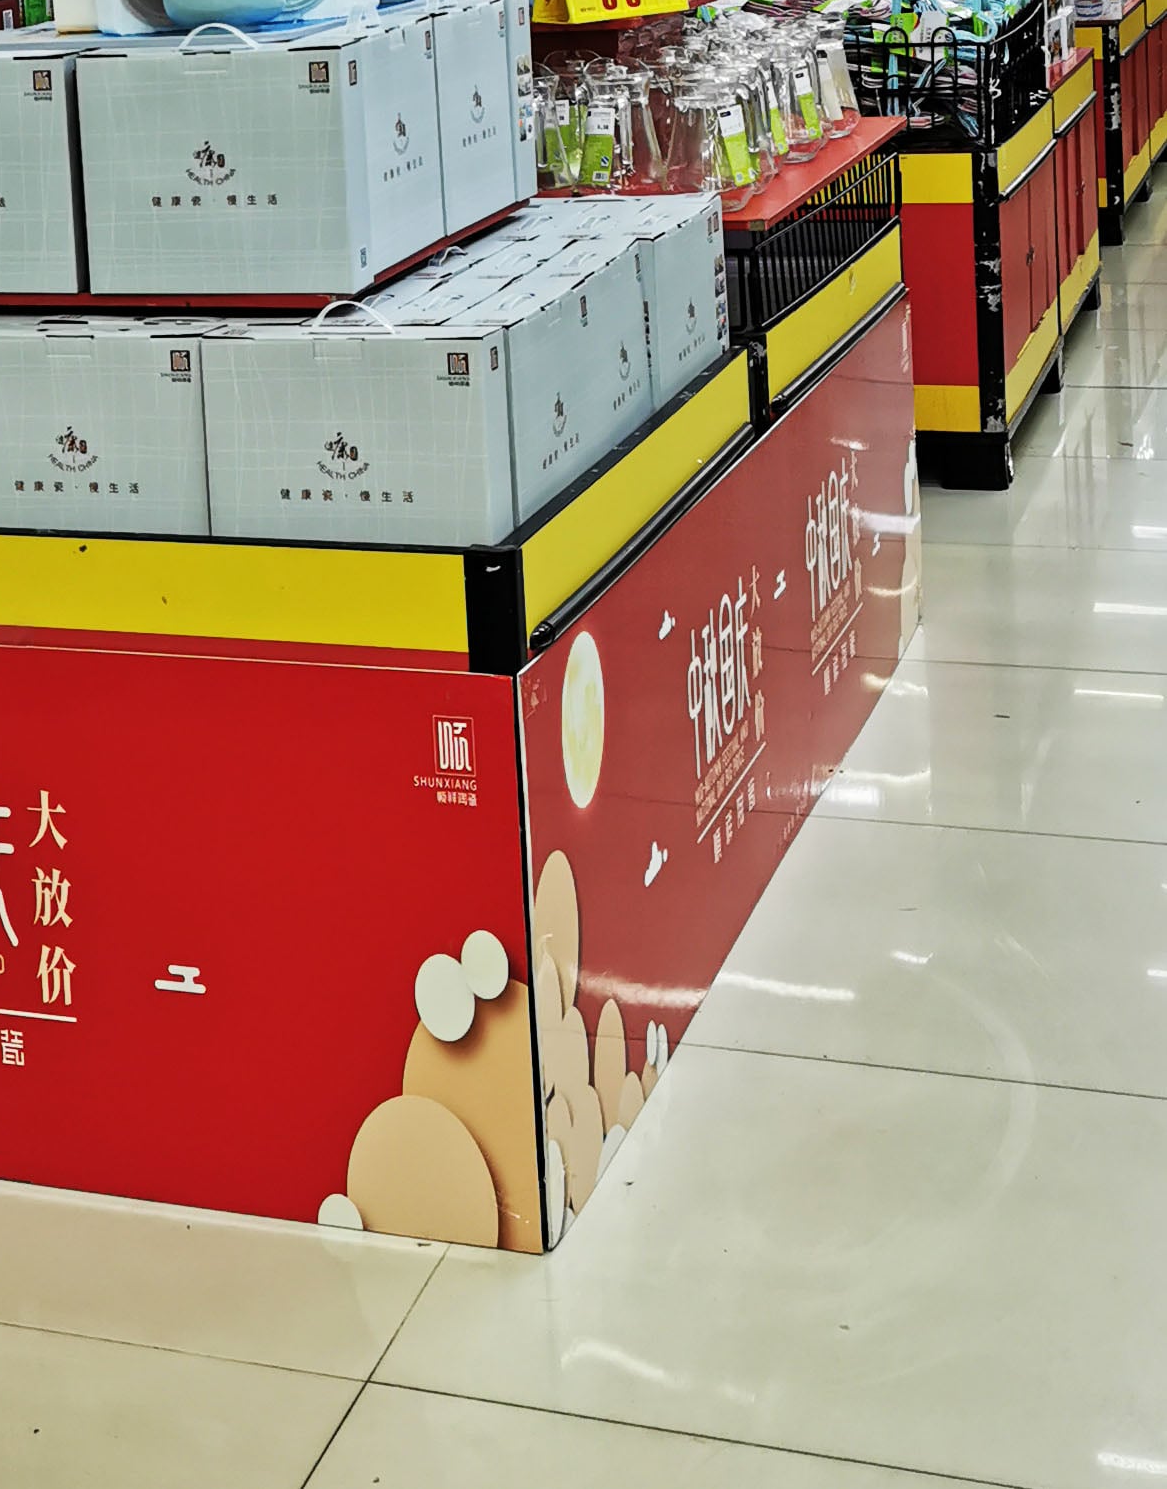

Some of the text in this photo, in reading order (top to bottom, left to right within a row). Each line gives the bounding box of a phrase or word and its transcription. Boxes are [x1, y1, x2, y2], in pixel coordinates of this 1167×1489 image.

[687, 576, 751, 780] 中秋国庆
[413, 775, 477, 791] SHUNXIANG
[27, 789, 77, 1007] 大放价
